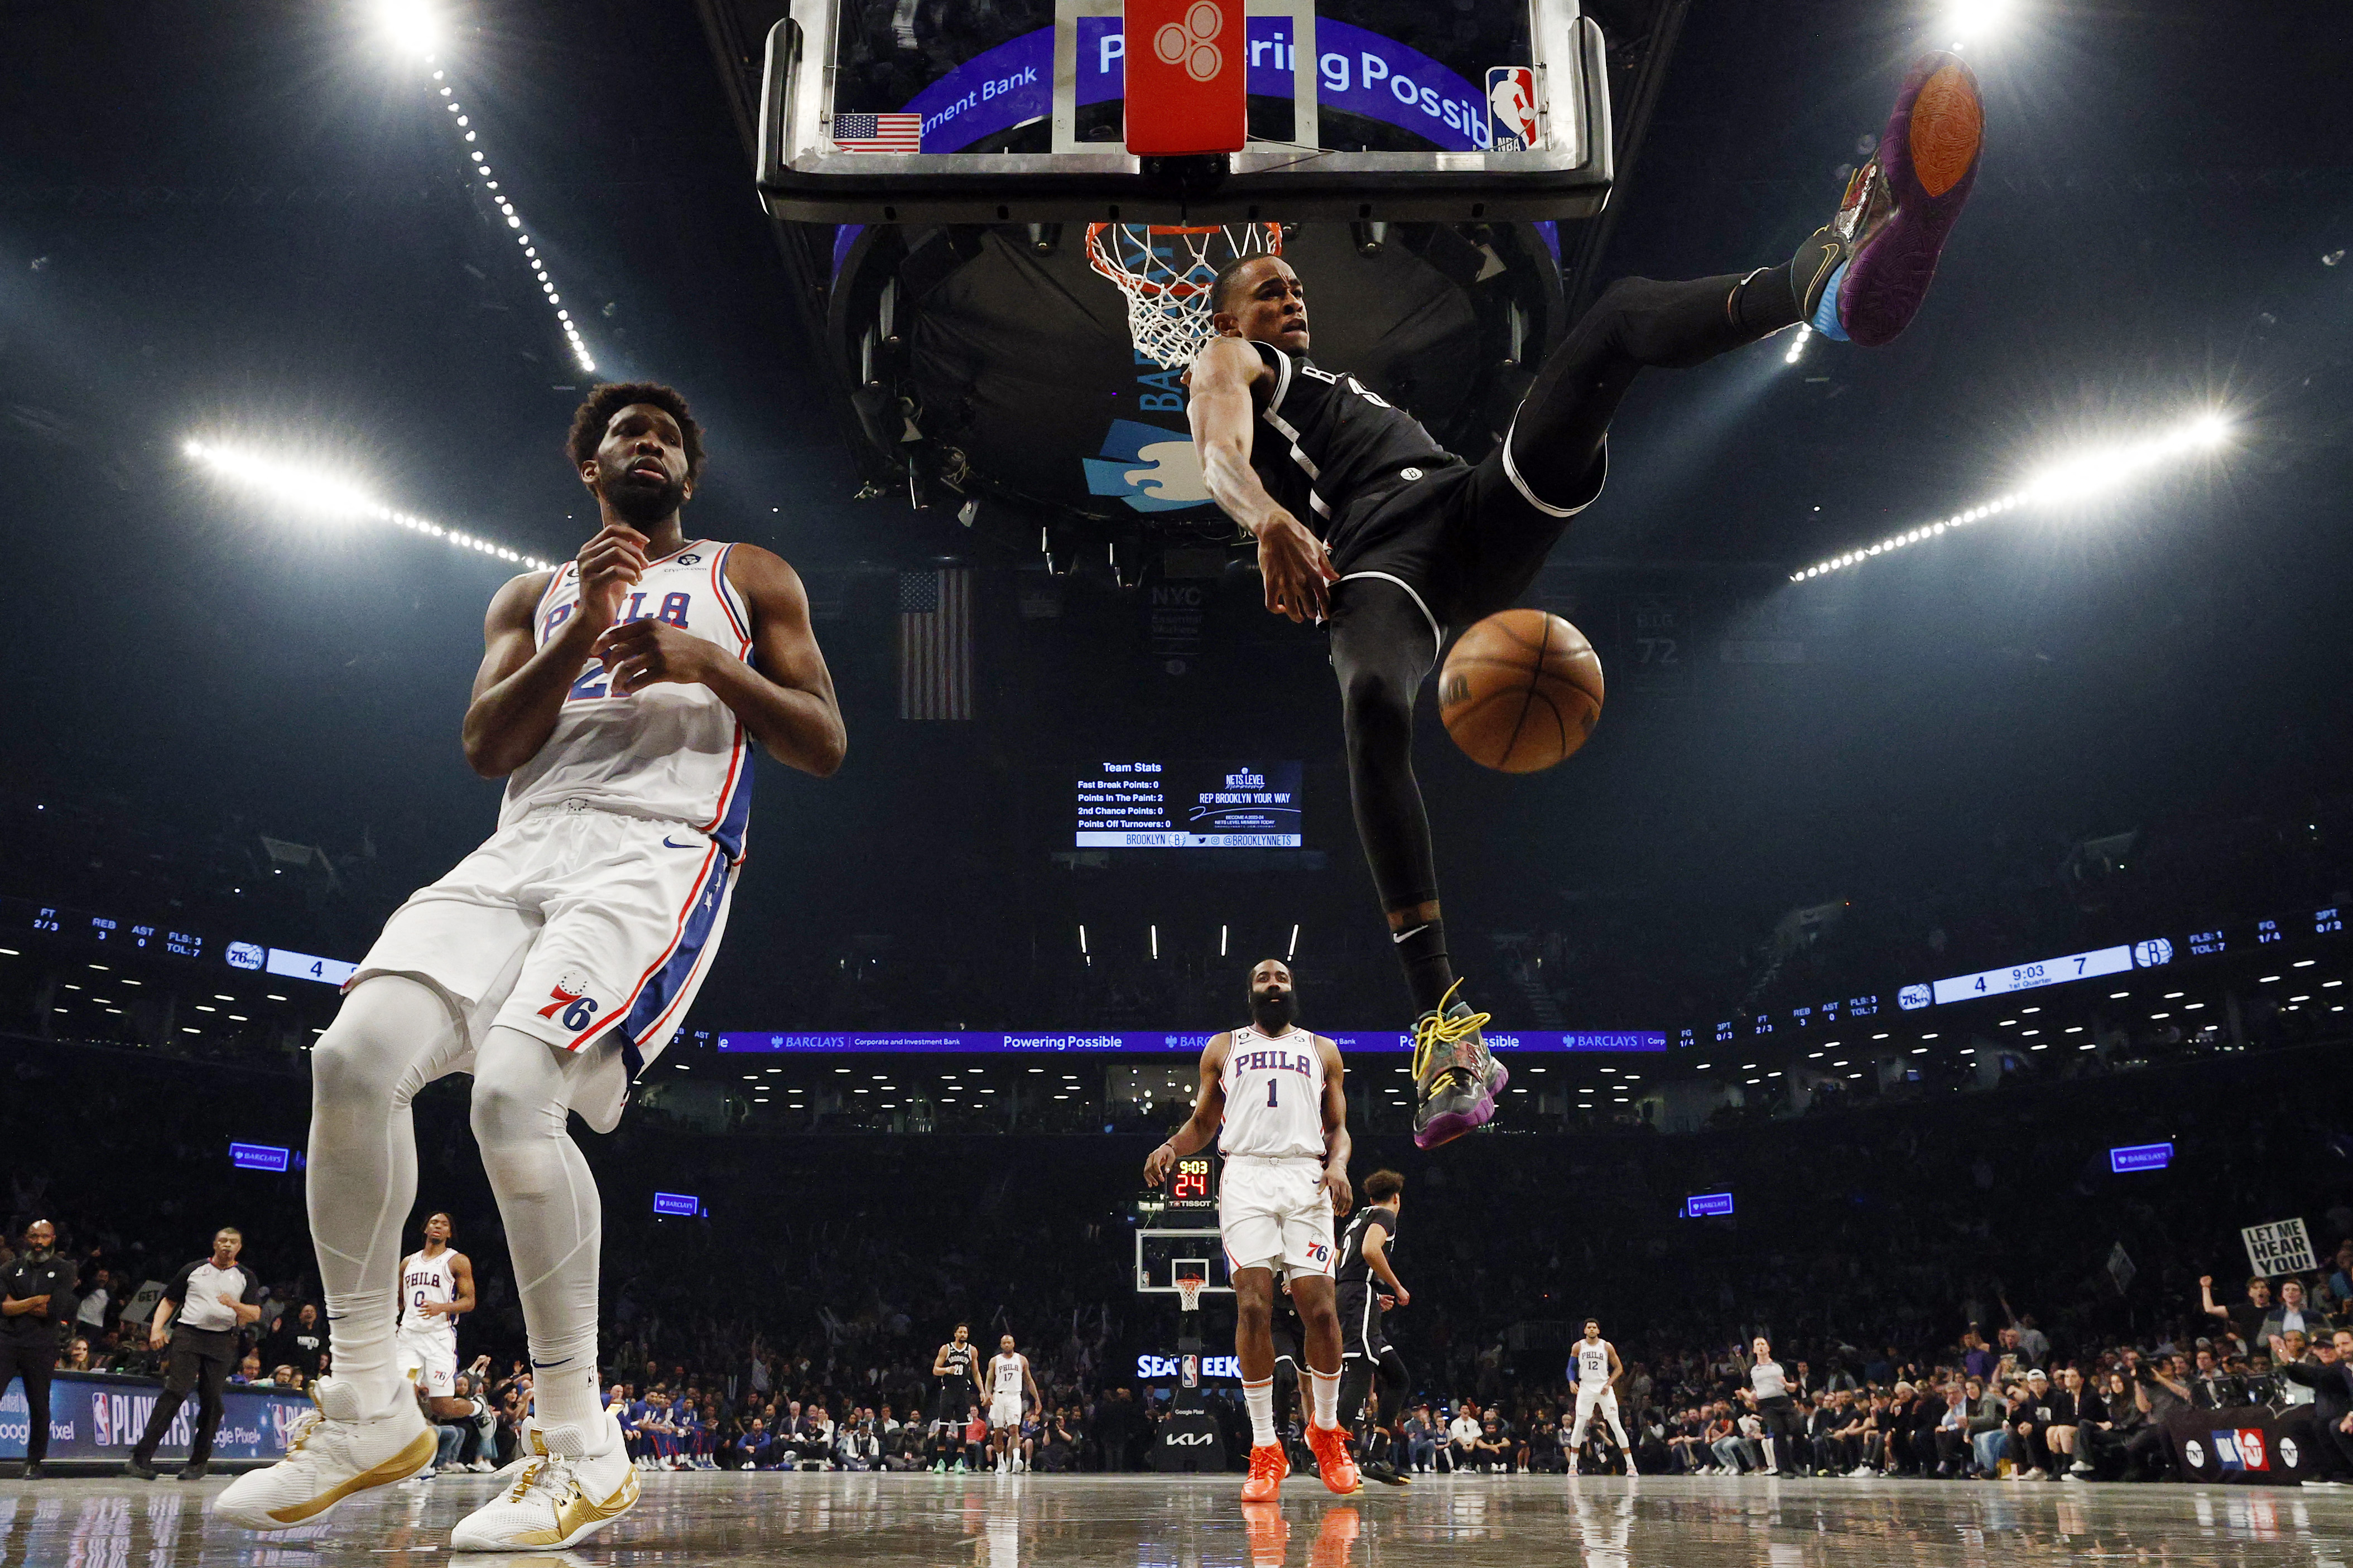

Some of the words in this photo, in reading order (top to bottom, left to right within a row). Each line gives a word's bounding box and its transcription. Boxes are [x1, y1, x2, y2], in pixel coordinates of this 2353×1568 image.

[1100, 33, 1349, 91] Prig
[982, 66, 1037, 102] Bank
[542, 591, 691, 646] PLA
[1103, 763, 1132, 772] Team
[1134, 763, 1162, 772] Stats
[1226, 775, 1244, 785] NETS
[1245, 775, 1265, 785] LEVEL
[1200, 793, 1214, 803] REP
[1215, 793, 1252, 803] BROOKLYN
[1253, 793, 1272, 803] YOUR
[1274, 793, 1291, 803] WAY
[1127, 834, 1166, 845] BROOKLYN
[1223, 835, 1291, 846] @BROOKLYNNETS
[40, 908, 56, 918] FT
[92, 918, 117, 929] REB
[2259, 920, 2276, 931] FG
[98, 931, 106, 940] 3
[132, 925, 155, 936] AST
[138, 938, 146, 947] 0
[169, 932, 192, 944] FLS:
[195, 937, 202, 945] 3
[2190, 932, 2215, 943] FLS:
[167, 943, 191, 955] TOL:
[193, 949, 200, 957] 7
[2191, 944, 2216, 955] TOL:
[2218, 942, 2225, 951] 7
[310, 961, 323, 977] 4
[2073, 957, 2087, 974] 7
[2013, 966, 2044, 980] 9:03
[1975, 976, 1986, 993] 4
[2023, 977, 2052, 987] Quarter
[1822, 1002, 1839, 1012] AST
[1850, 997, 1869, 1006] FLS:
[536, 985, 598, 1032] 76
[1793, 1007, 1811, 1017] REB
[1850, 1007, 1870, 1016] TOL:
[1757, 1015, 1768, 1024] FT
[1800, 1018, 1806, 1026] 3
[1829, 1013, 1835, 1022] 0
[1717, 1022, 1731, 1031] 3PT
[695, 1031, 709, 1039] AST
[786, 1037, 844, 1047] BARCLAYS
[1004, 1036, 1065, 1050] Powering
[1068, 1035, 1122, 1047] Possible
[1578, 1036, 1637, 1046] BARCLAYS
[1235, 1051, 1311, 1079] PHILA
[1267, 1078, 1278, 1108] 1
[244, 1152, 281, 1163] BARCLAYS
[1180, 1161, 1208, 1174] 9:03
[1176, 1174, 1204, 1196] 24
[2248, 1226, 2274, 1243] LET
[2277, 1221, 2301, 1238] ME
[1306, 1241, 1329, 1262] 76
[2252, 1236, 2307, 1260] HEAR
[2258, 1253, 2311, 1275] YOU!
[405, 1272, 440, 1289] PHILA
[138, 1290, 160, 1302] GET
[414, 1290, 424, 1308] 0
[947, 1355, 970, 1365] BROOKLYN
[1582, 1351, 1603, 1360] PHILA
[999, 1364, 1019, 1374] PHILA
[1137, 1354, 1243, 1378] SEAEEK
[1588, 1361, 1598, 1370] 12
[434, 1371, 446, 1381] 76
[1004, 1373, 1013, 1381] 17
[0, 1419, 30, 1445] oogl
[50, 1420, 74, 1440] ixel
[235, 1426, 258, 1444] Pixel
